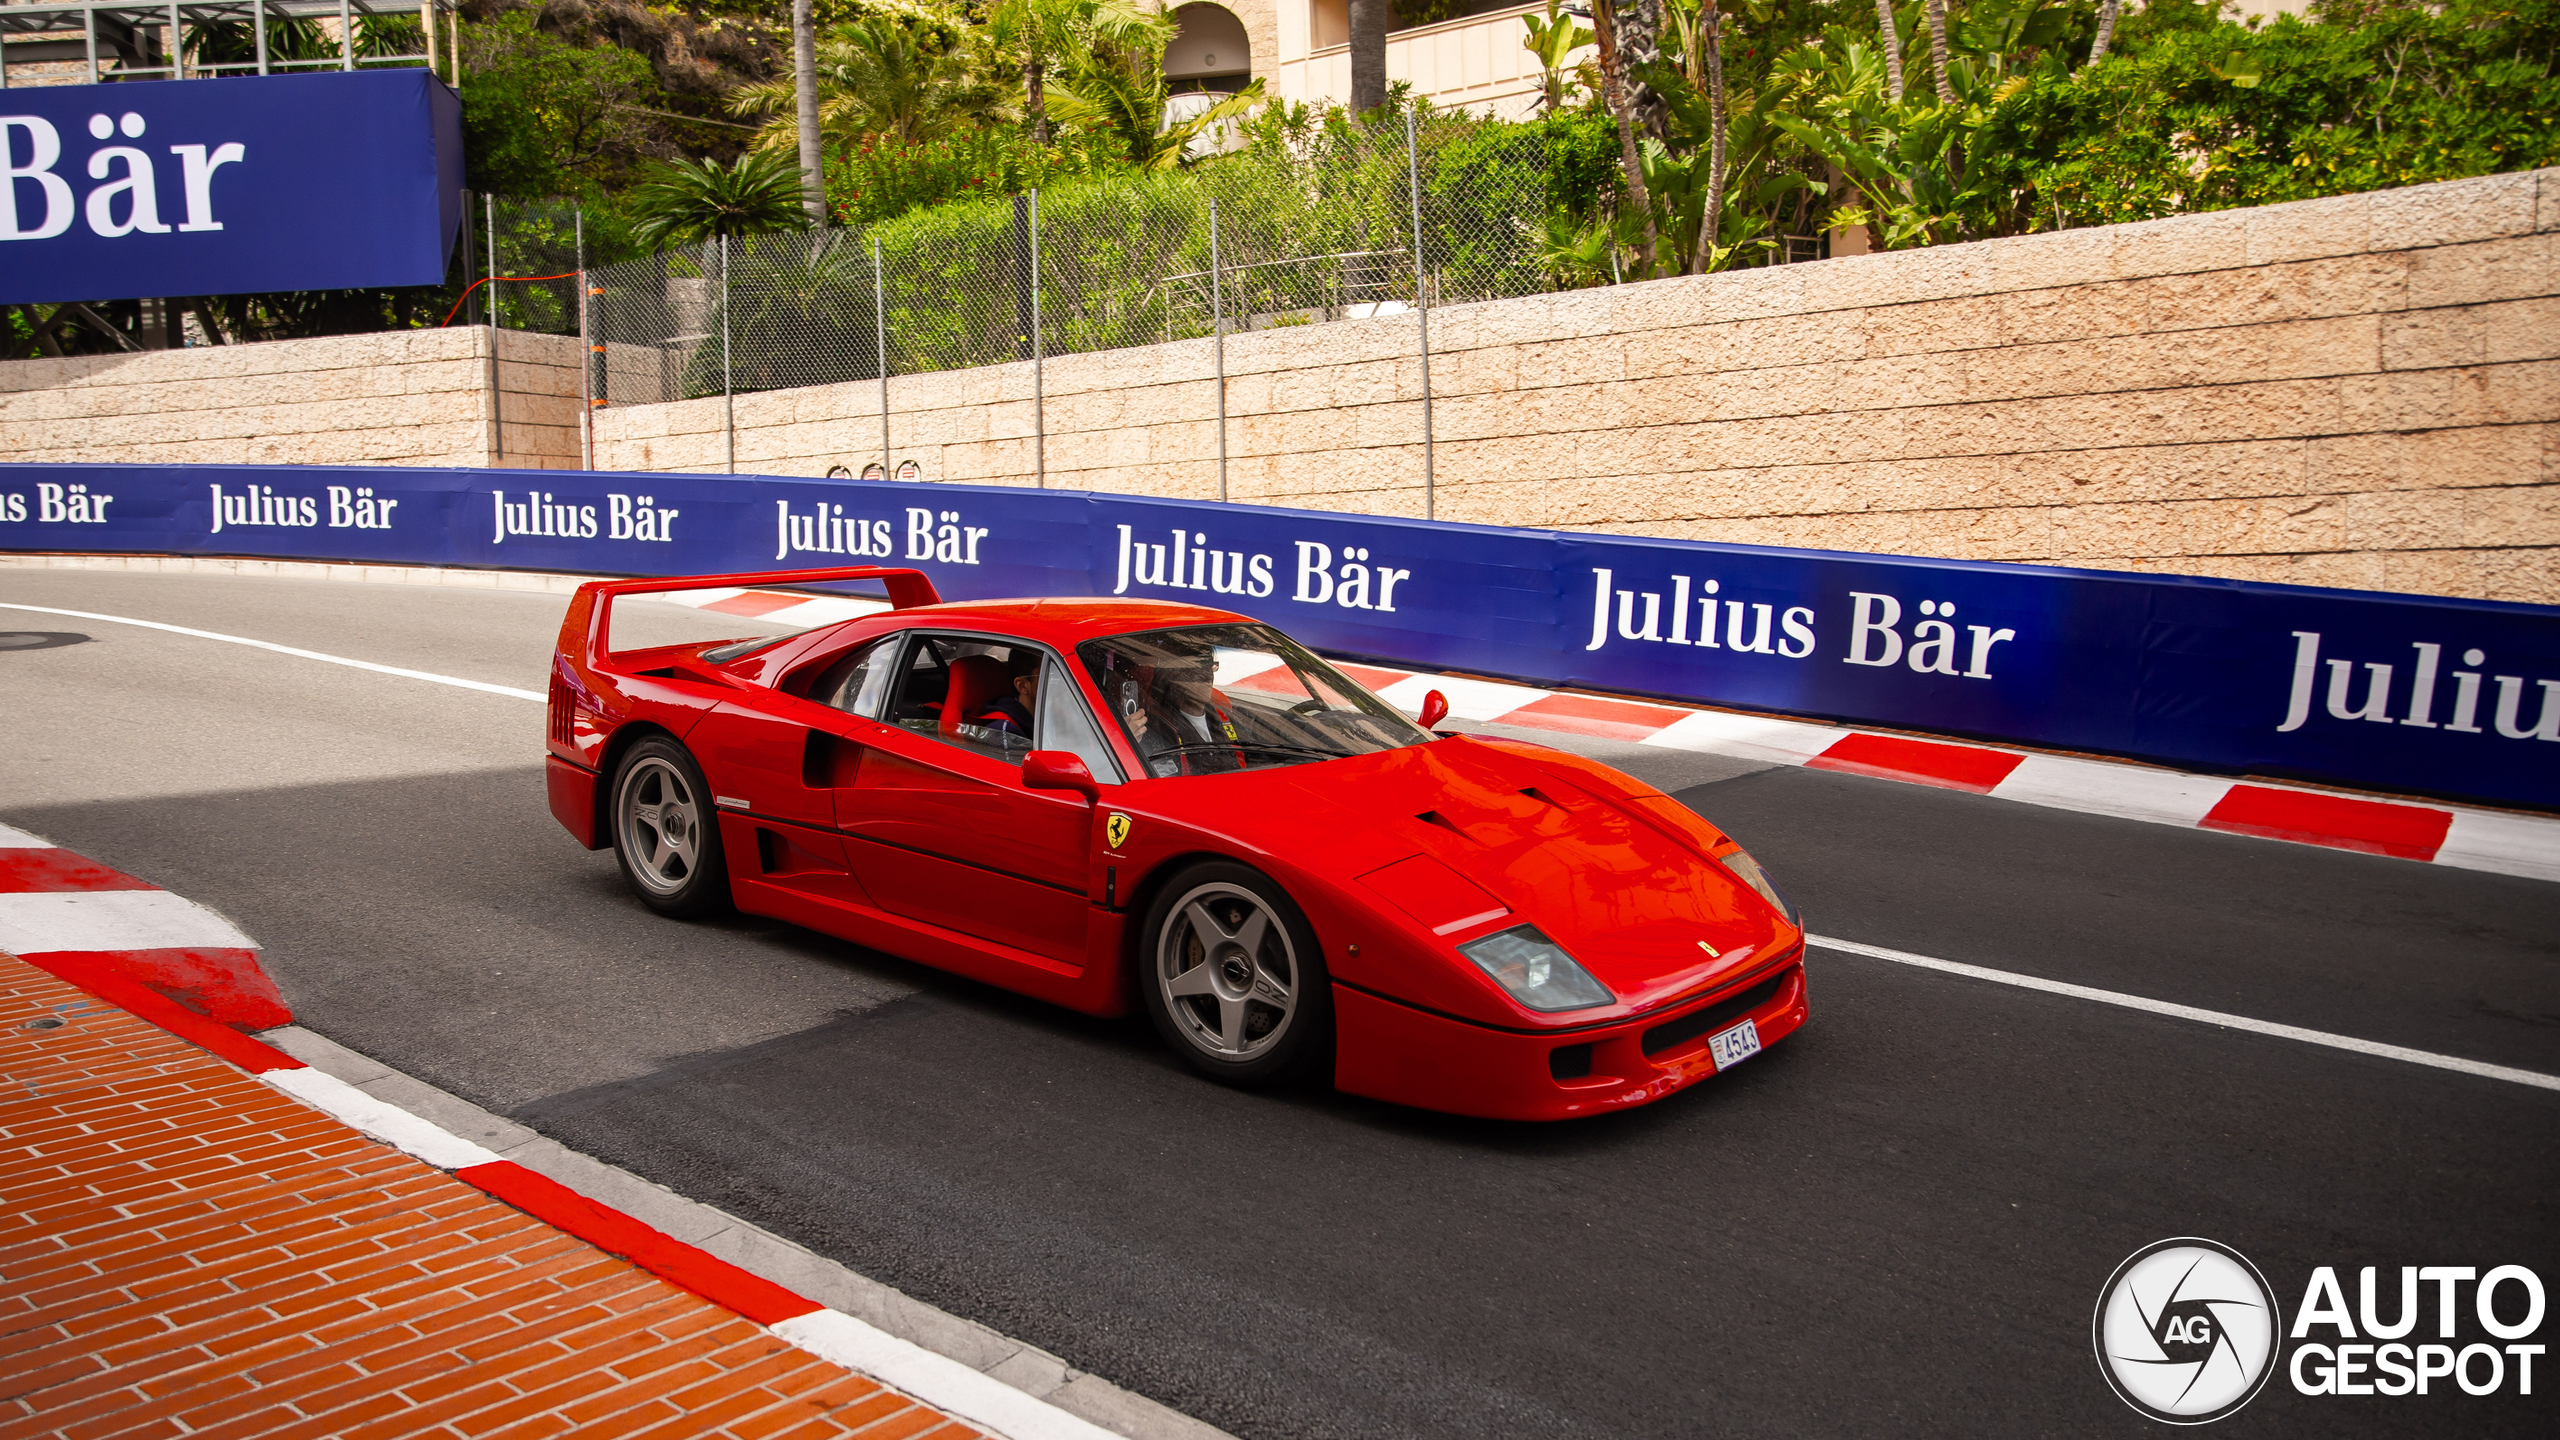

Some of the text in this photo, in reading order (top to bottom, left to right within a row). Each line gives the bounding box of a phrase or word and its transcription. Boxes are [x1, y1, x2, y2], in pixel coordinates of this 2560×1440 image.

[0, 112, 245, 240] Bär
[37, 483, 113, 523] Bär
[210, 484, 397, 533] Julius Bär
[493, 490, 679, 544] Julius Bär
[776, 500, 988, 564] Julius Bär
[1113, 525, 1410, 612] Julius Bär
[1586, 568, 2015, 679] Julius Bär
[2277, 631, 2560, 741] Juliu
[1725, 1025, 1756, 1059] 4543
